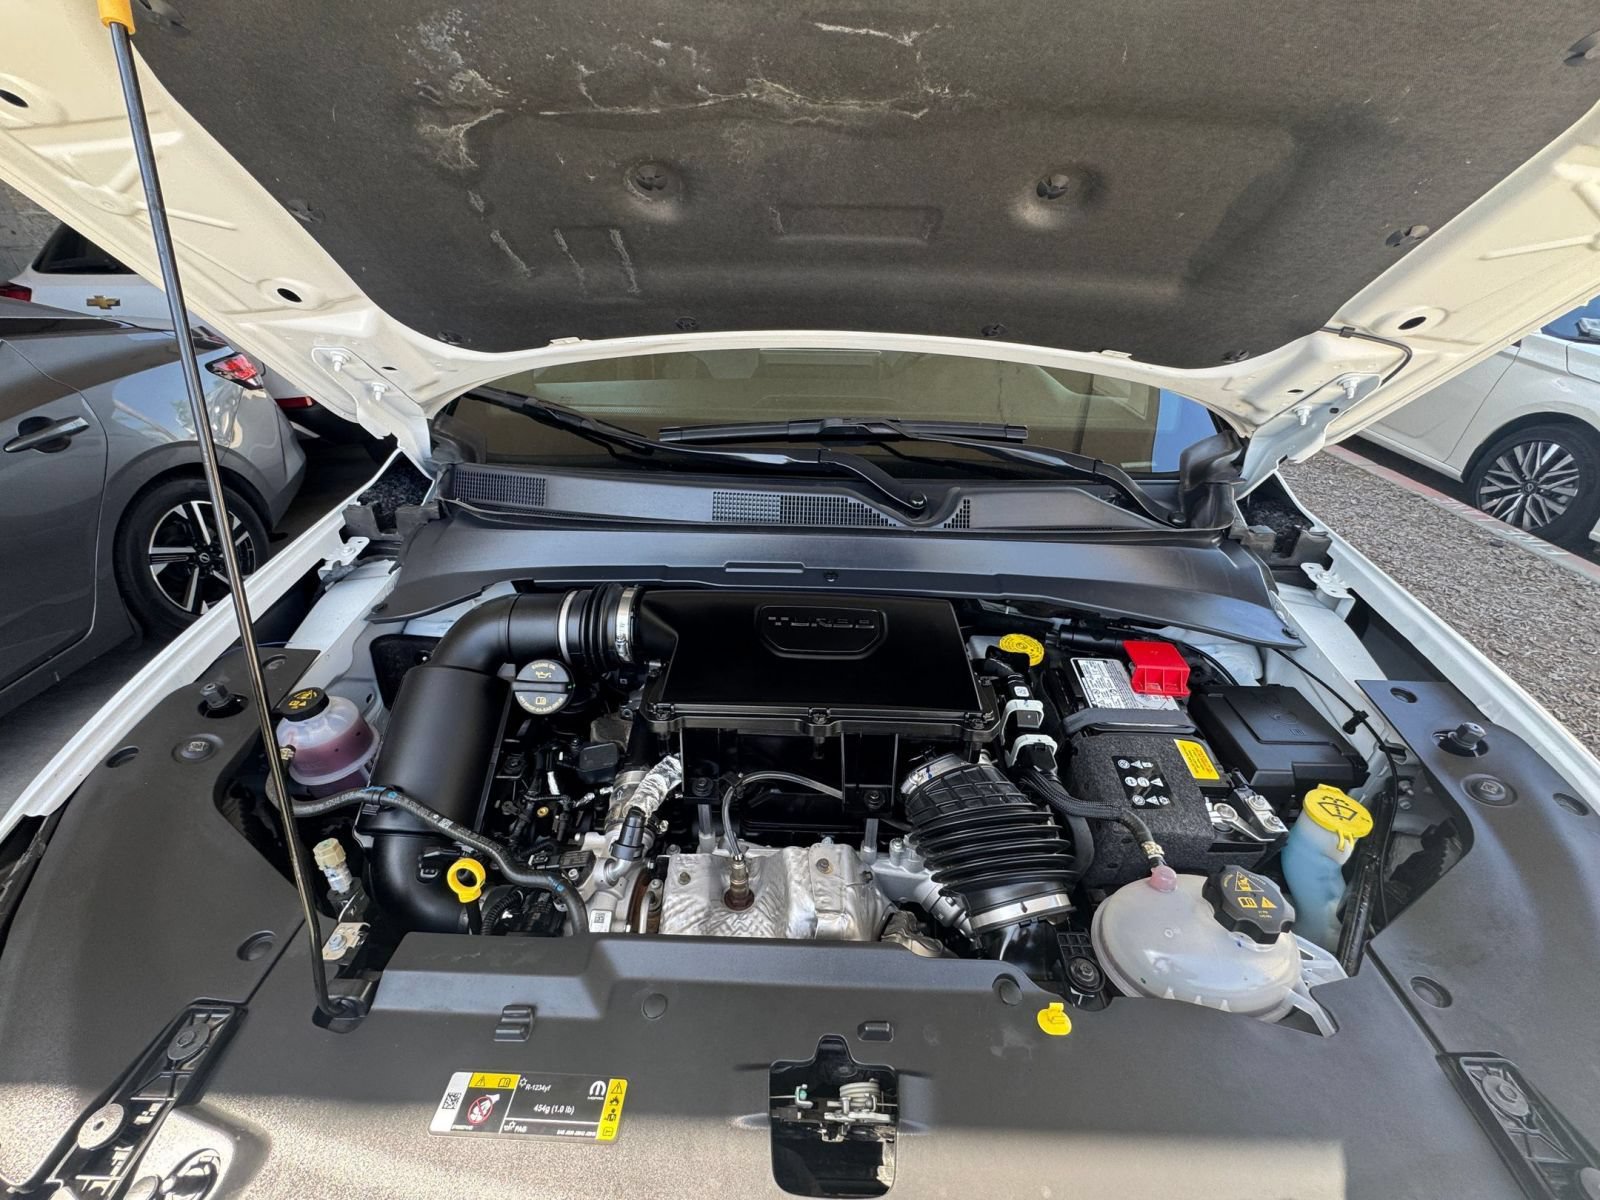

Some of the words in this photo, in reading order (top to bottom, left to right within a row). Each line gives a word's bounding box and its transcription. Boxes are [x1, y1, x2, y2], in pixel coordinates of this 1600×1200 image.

[525, 1084, 552, 1093] R-1234yf
[533, 1103, 551, 1115] 454g
[551, 1104, 564, 1115] (1.0
[564, 1105, 575, 1116] lb)
